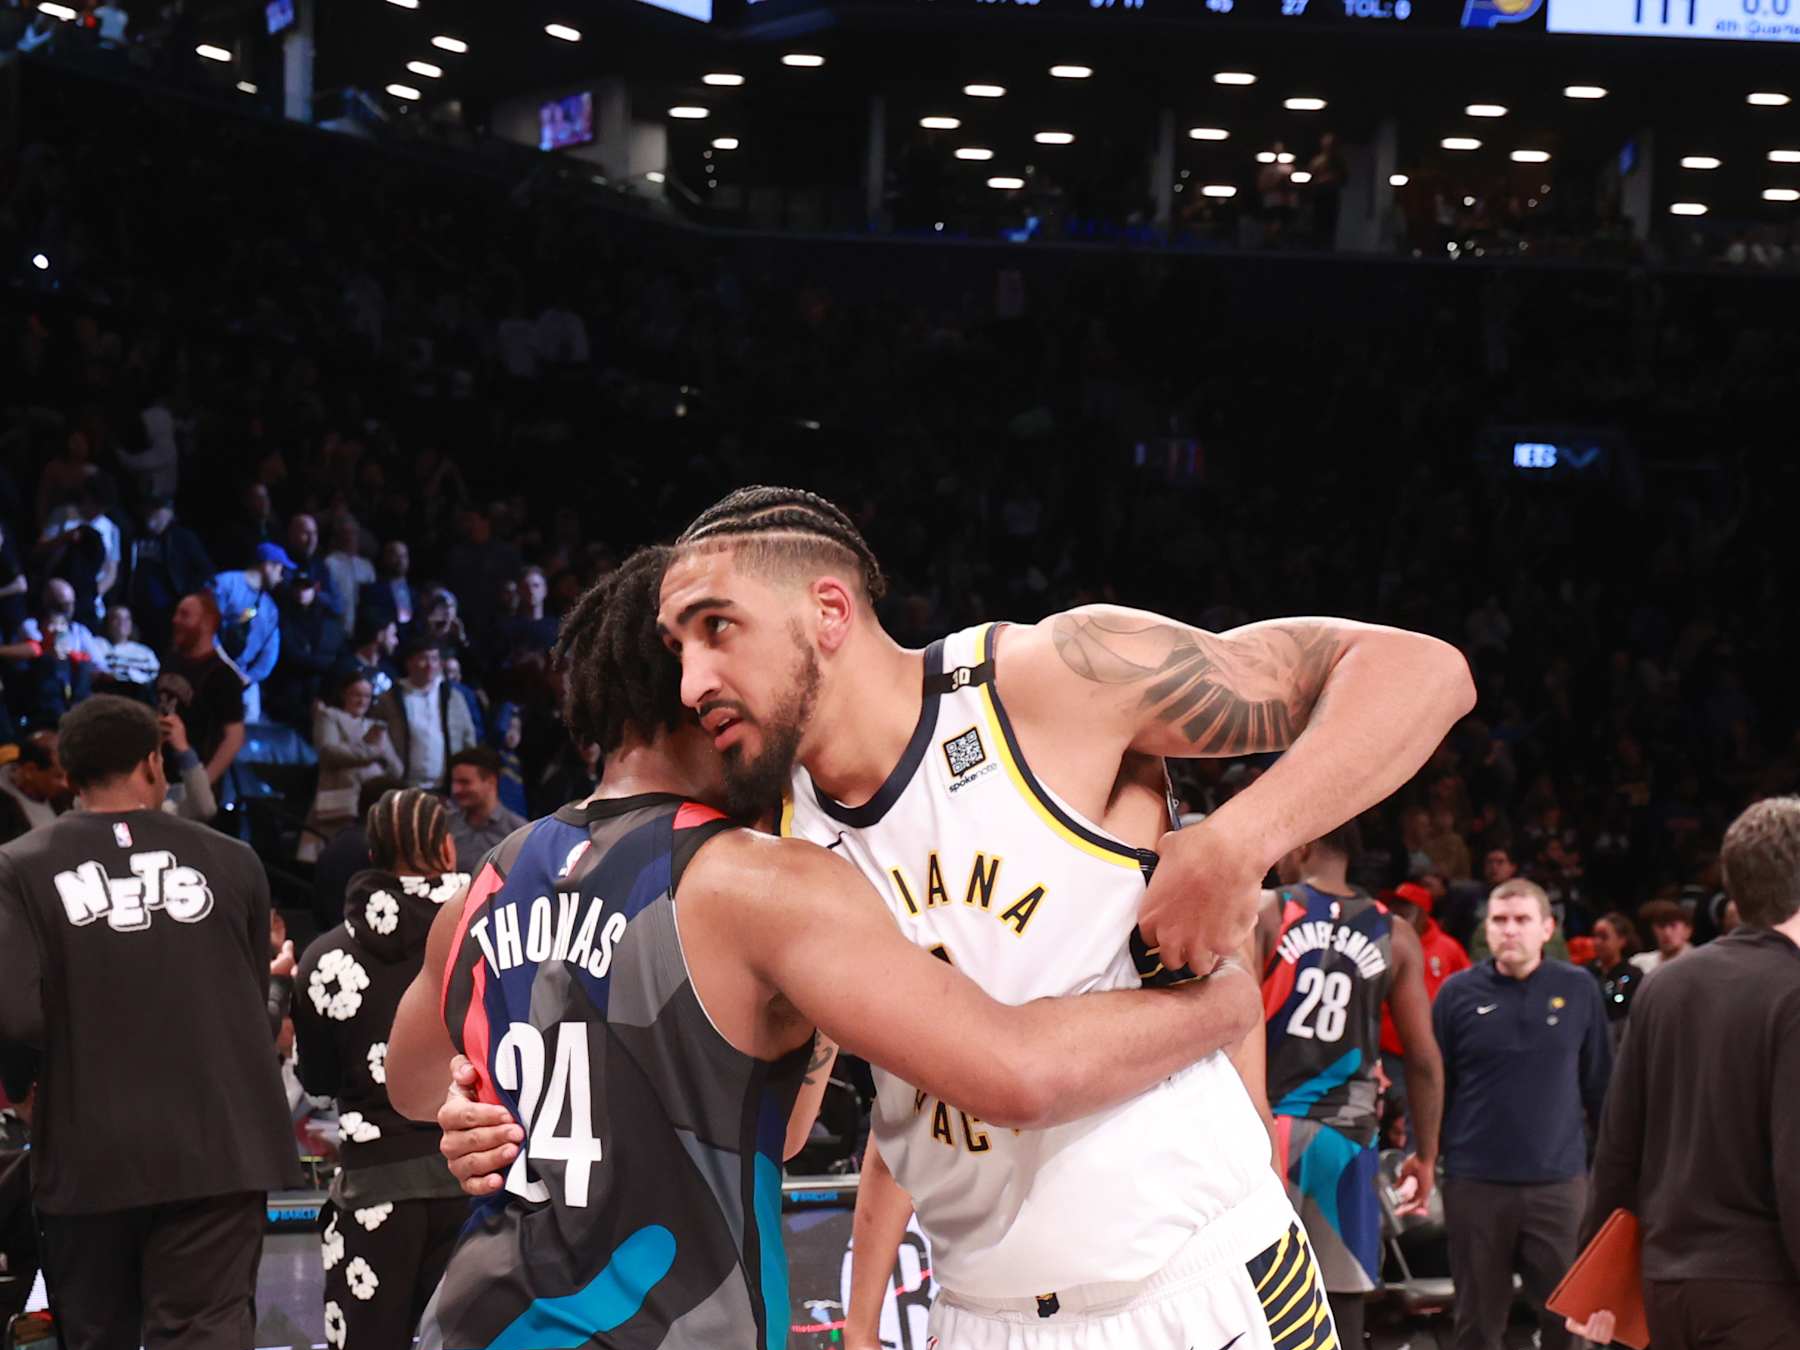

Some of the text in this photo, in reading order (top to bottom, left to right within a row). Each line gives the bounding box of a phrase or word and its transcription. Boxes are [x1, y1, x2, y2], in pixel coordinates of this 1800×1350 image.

[948, 761, 998, 793] spokenote
[54, 850, 214, 932] NETS
[891, 849, 1049, 937] IANA
[470, 892, 627, 980] THOMAS
[1285, 966, 1352, 1042] 28
[495, 1021, 602, 1208] 24
